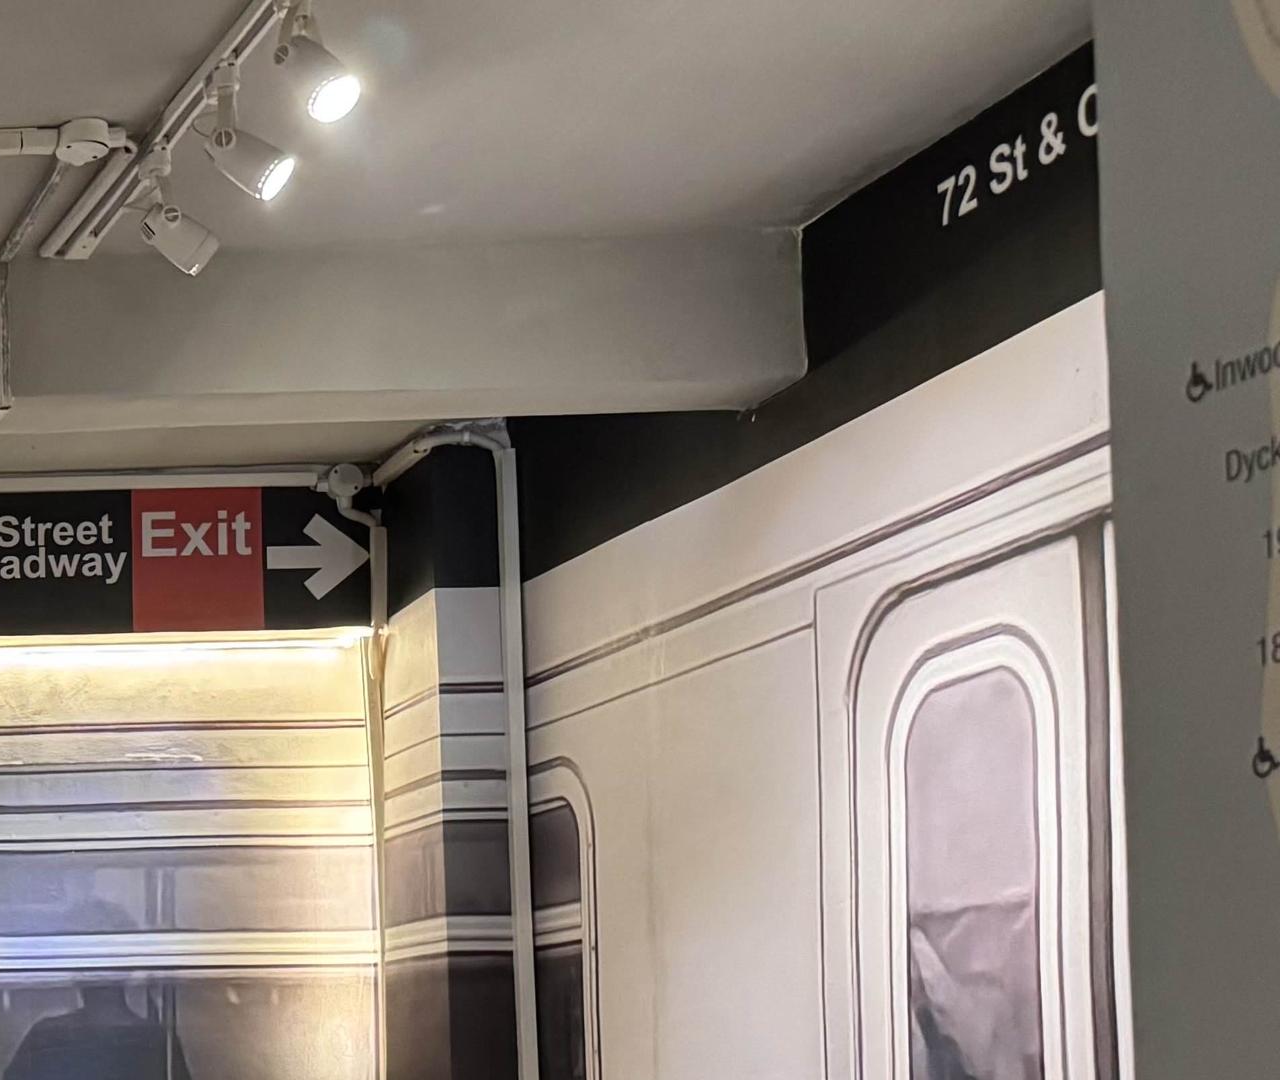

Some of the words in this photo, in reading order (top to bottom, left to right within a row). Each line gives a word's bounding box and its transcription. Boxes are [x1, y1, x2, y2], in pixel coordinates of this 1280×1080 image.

[937, 165, 978, 226] 72
[988, 135, 1028, 196] St
[1039, 112, 1066, 166] &
[141, 510, 252, 558] Exit
